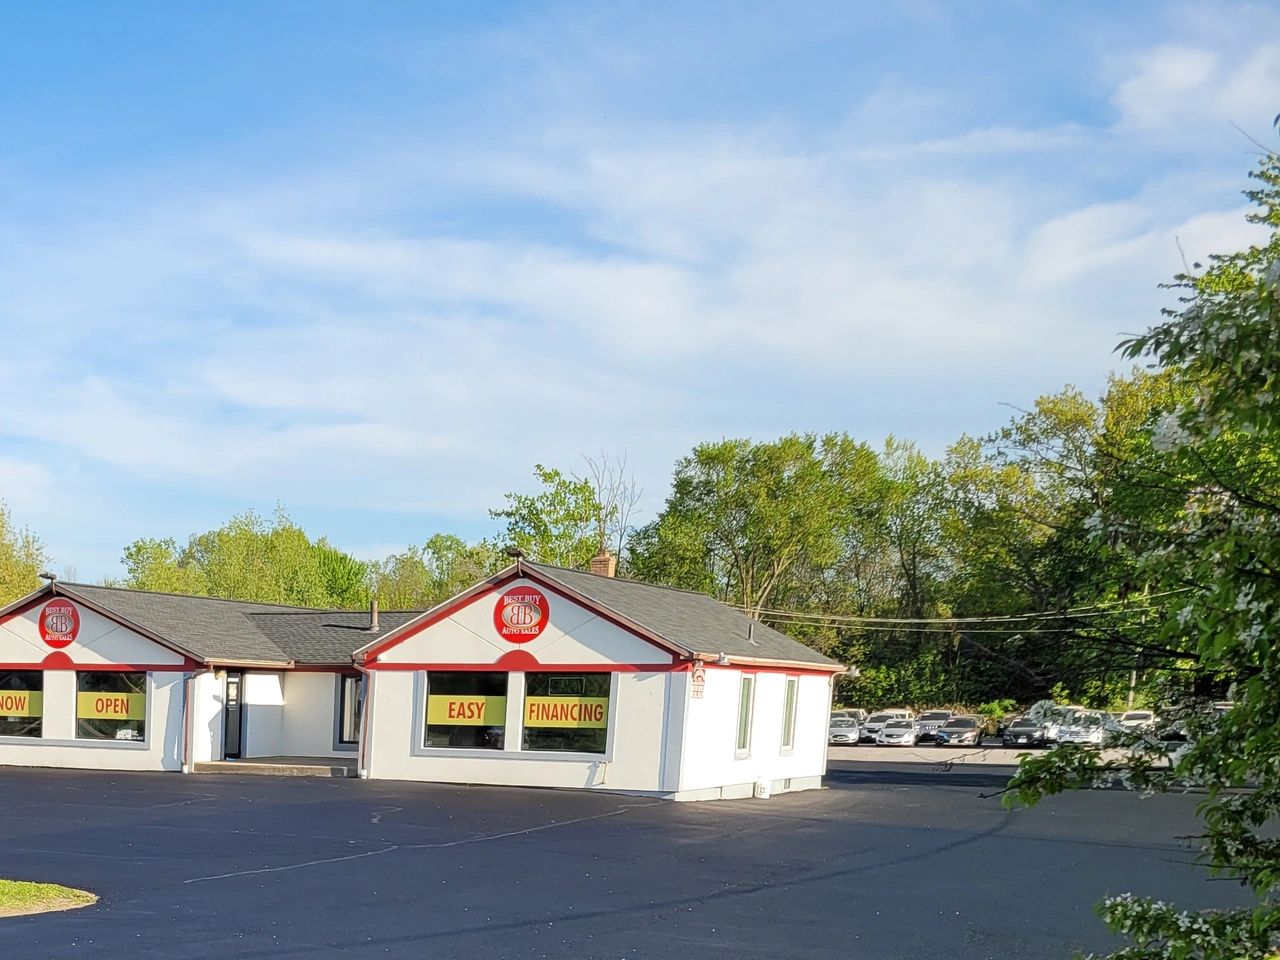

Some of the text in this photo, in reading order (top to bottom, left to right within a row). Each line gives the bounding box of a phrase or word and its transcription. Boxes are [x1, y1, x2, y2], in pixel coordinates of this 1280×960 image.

[504, 595, 541, 605] BEST BUY
[502, 626, 539, 635] AUTO SALES
[95, 698, 129, 714] OPEN
[448, 701, 485, 719] EASY
[528, 702, 604, 722] FINANCING
